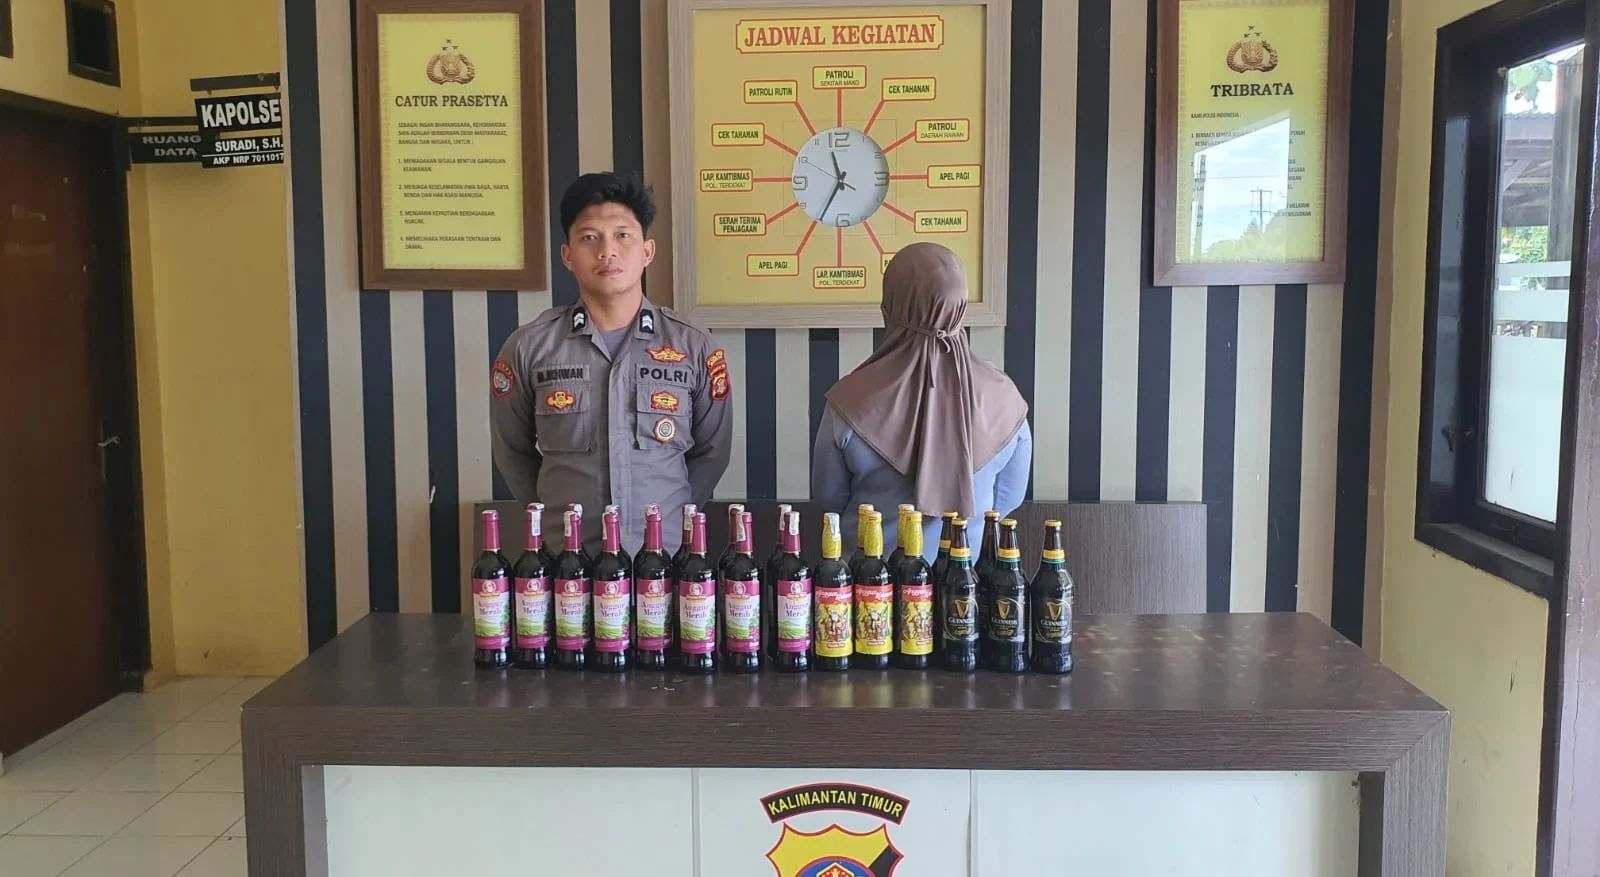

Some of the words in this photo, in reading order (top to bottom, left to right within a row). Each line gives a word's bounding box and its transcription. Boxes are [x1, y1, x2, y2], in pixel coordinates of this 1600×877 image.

[745, 27, 825, 47] JADWAL
[832, 24, 936, 44] KEGIATAN
[825, 69, 854, 80] PATROLI
[749, 87, 775, 98] PATROLI
[776, 87, 793, 98] RUTIN
[889, 86, 901, 96] CEK
[902, 85, 930, 96] TAHANAN
[1211, 83, 1294, 97] TRIBRATA
[395, 96, 438, 107] CATUR
[442, 96, 509, 107] PRASETYA
[201, 99, 282, 127] KAPOLSE
[928, 121, 957, 132] PATROLI
[142, 135, 202, 145] RUANG
[718, 130, 731, 141] CEK
[732, 130, 759, 141] TAHANAN
[828, 131, 851, 149] 12
[215, 139, 260, 152] SURADI,
[154, 148, 198, 157] DATA
[213, 157, 230, 165] AKP
[233, 155, 250, 164] NRP
[703, 172, 714, 182] LAP.
[716, 172, 750, 182] KAMTIBMAS
[939, 171, 953, 181] APEL
[955, 171, 969, 181] PAGI
[719, 216, 738, 227] SERAH
[740, 216, 762, 227] TERIMA
[835, 213, 851, 228] 6
[921, 216, 933, 226] CEK
[934, 216, 962, 226] TAHANAN
[723, 225, 758, 235] PENJAGAAN
[759, 260, 773, 271] APEL
[774, 260, 788, 271] PAGI
[817, 270, 828, 280] LAP.
[829, 269, 865, 280] KAMTIBMAS
[639, 367, 688, 384] POLRI
[768, 790, 856, 815] KALIMANTAN
[861, 793, 903, 817] TIMUR
